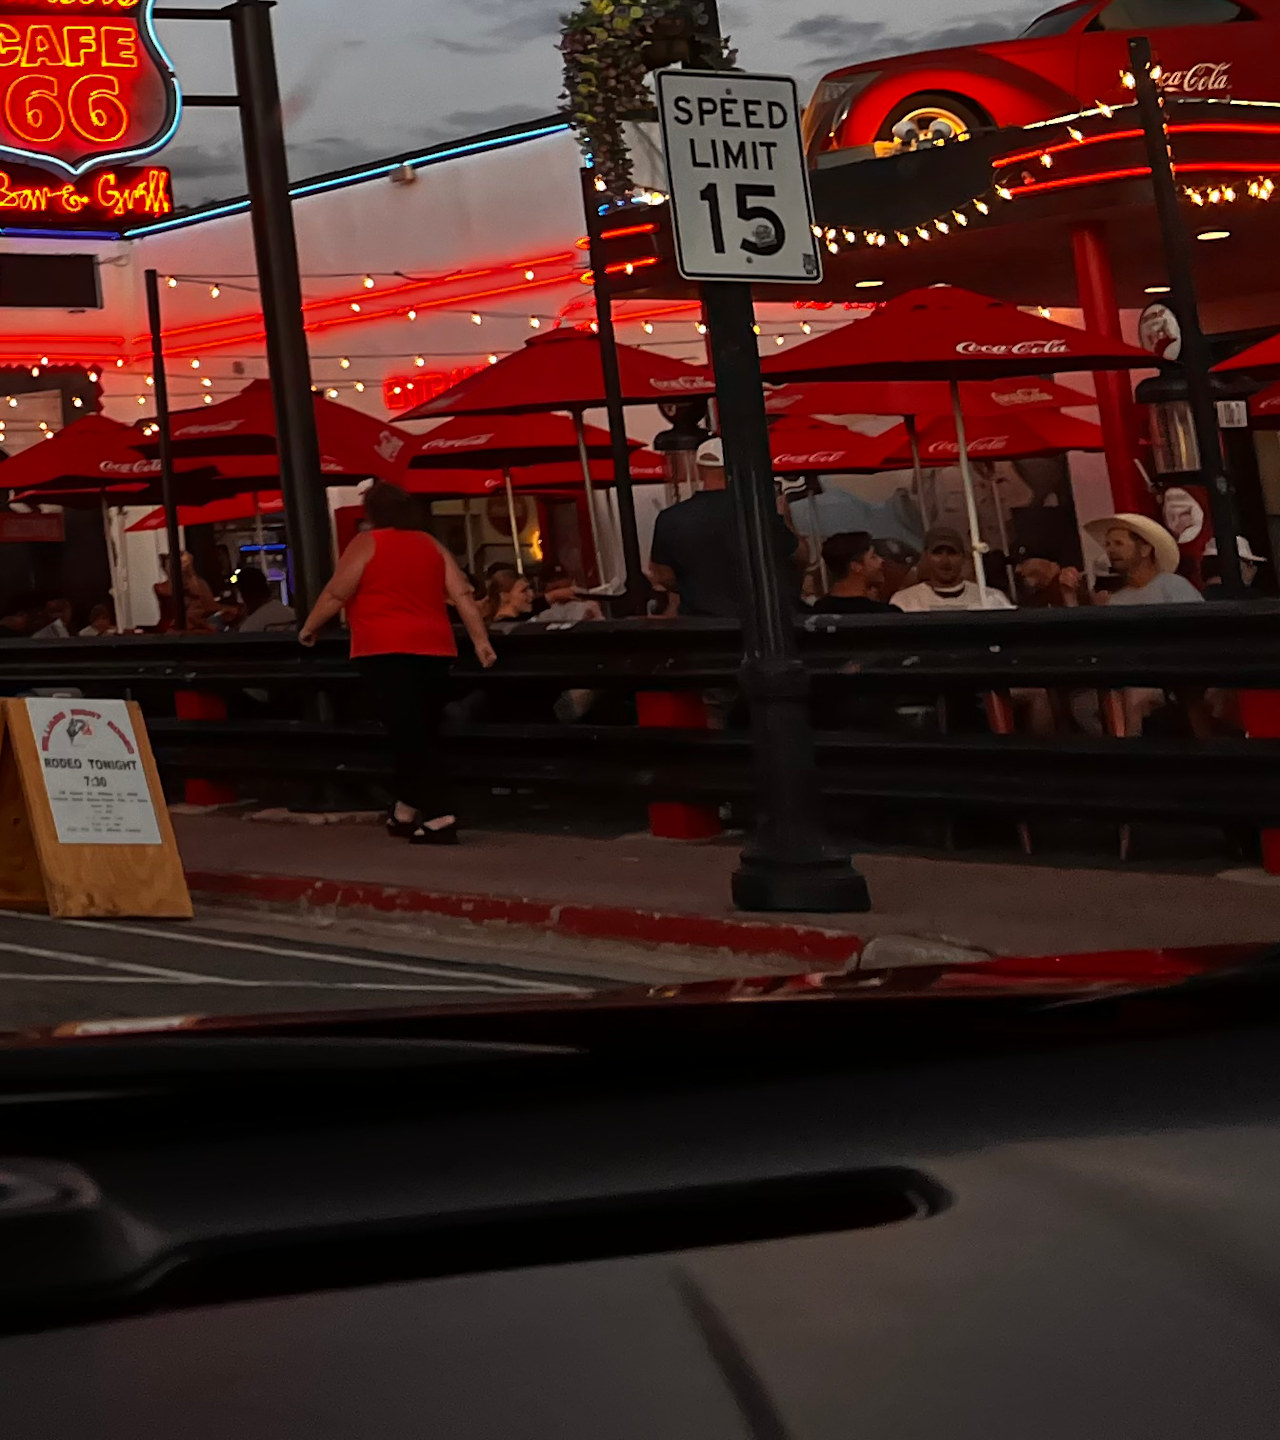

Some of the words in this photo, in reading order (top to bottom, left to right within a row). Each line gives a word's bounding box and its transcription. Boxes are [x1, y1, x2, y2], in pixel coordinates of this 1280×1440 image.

[1157, 62, 1232, 92] ca-Cola
[5, 74, 128, 142] 66
[673, 95, 788, 129] SPEED
[689, 138, 778, 171] LIMIT
[61, 184, 90, 212] &
[97, 169, 171, 215] Grill
[699, 182, 786, 257] 15
[955, 339, 1071, 355] Coca-Cola
[44, 758, 82, 770] RODEO
[88, 758, 137, 771] TONIGHT
